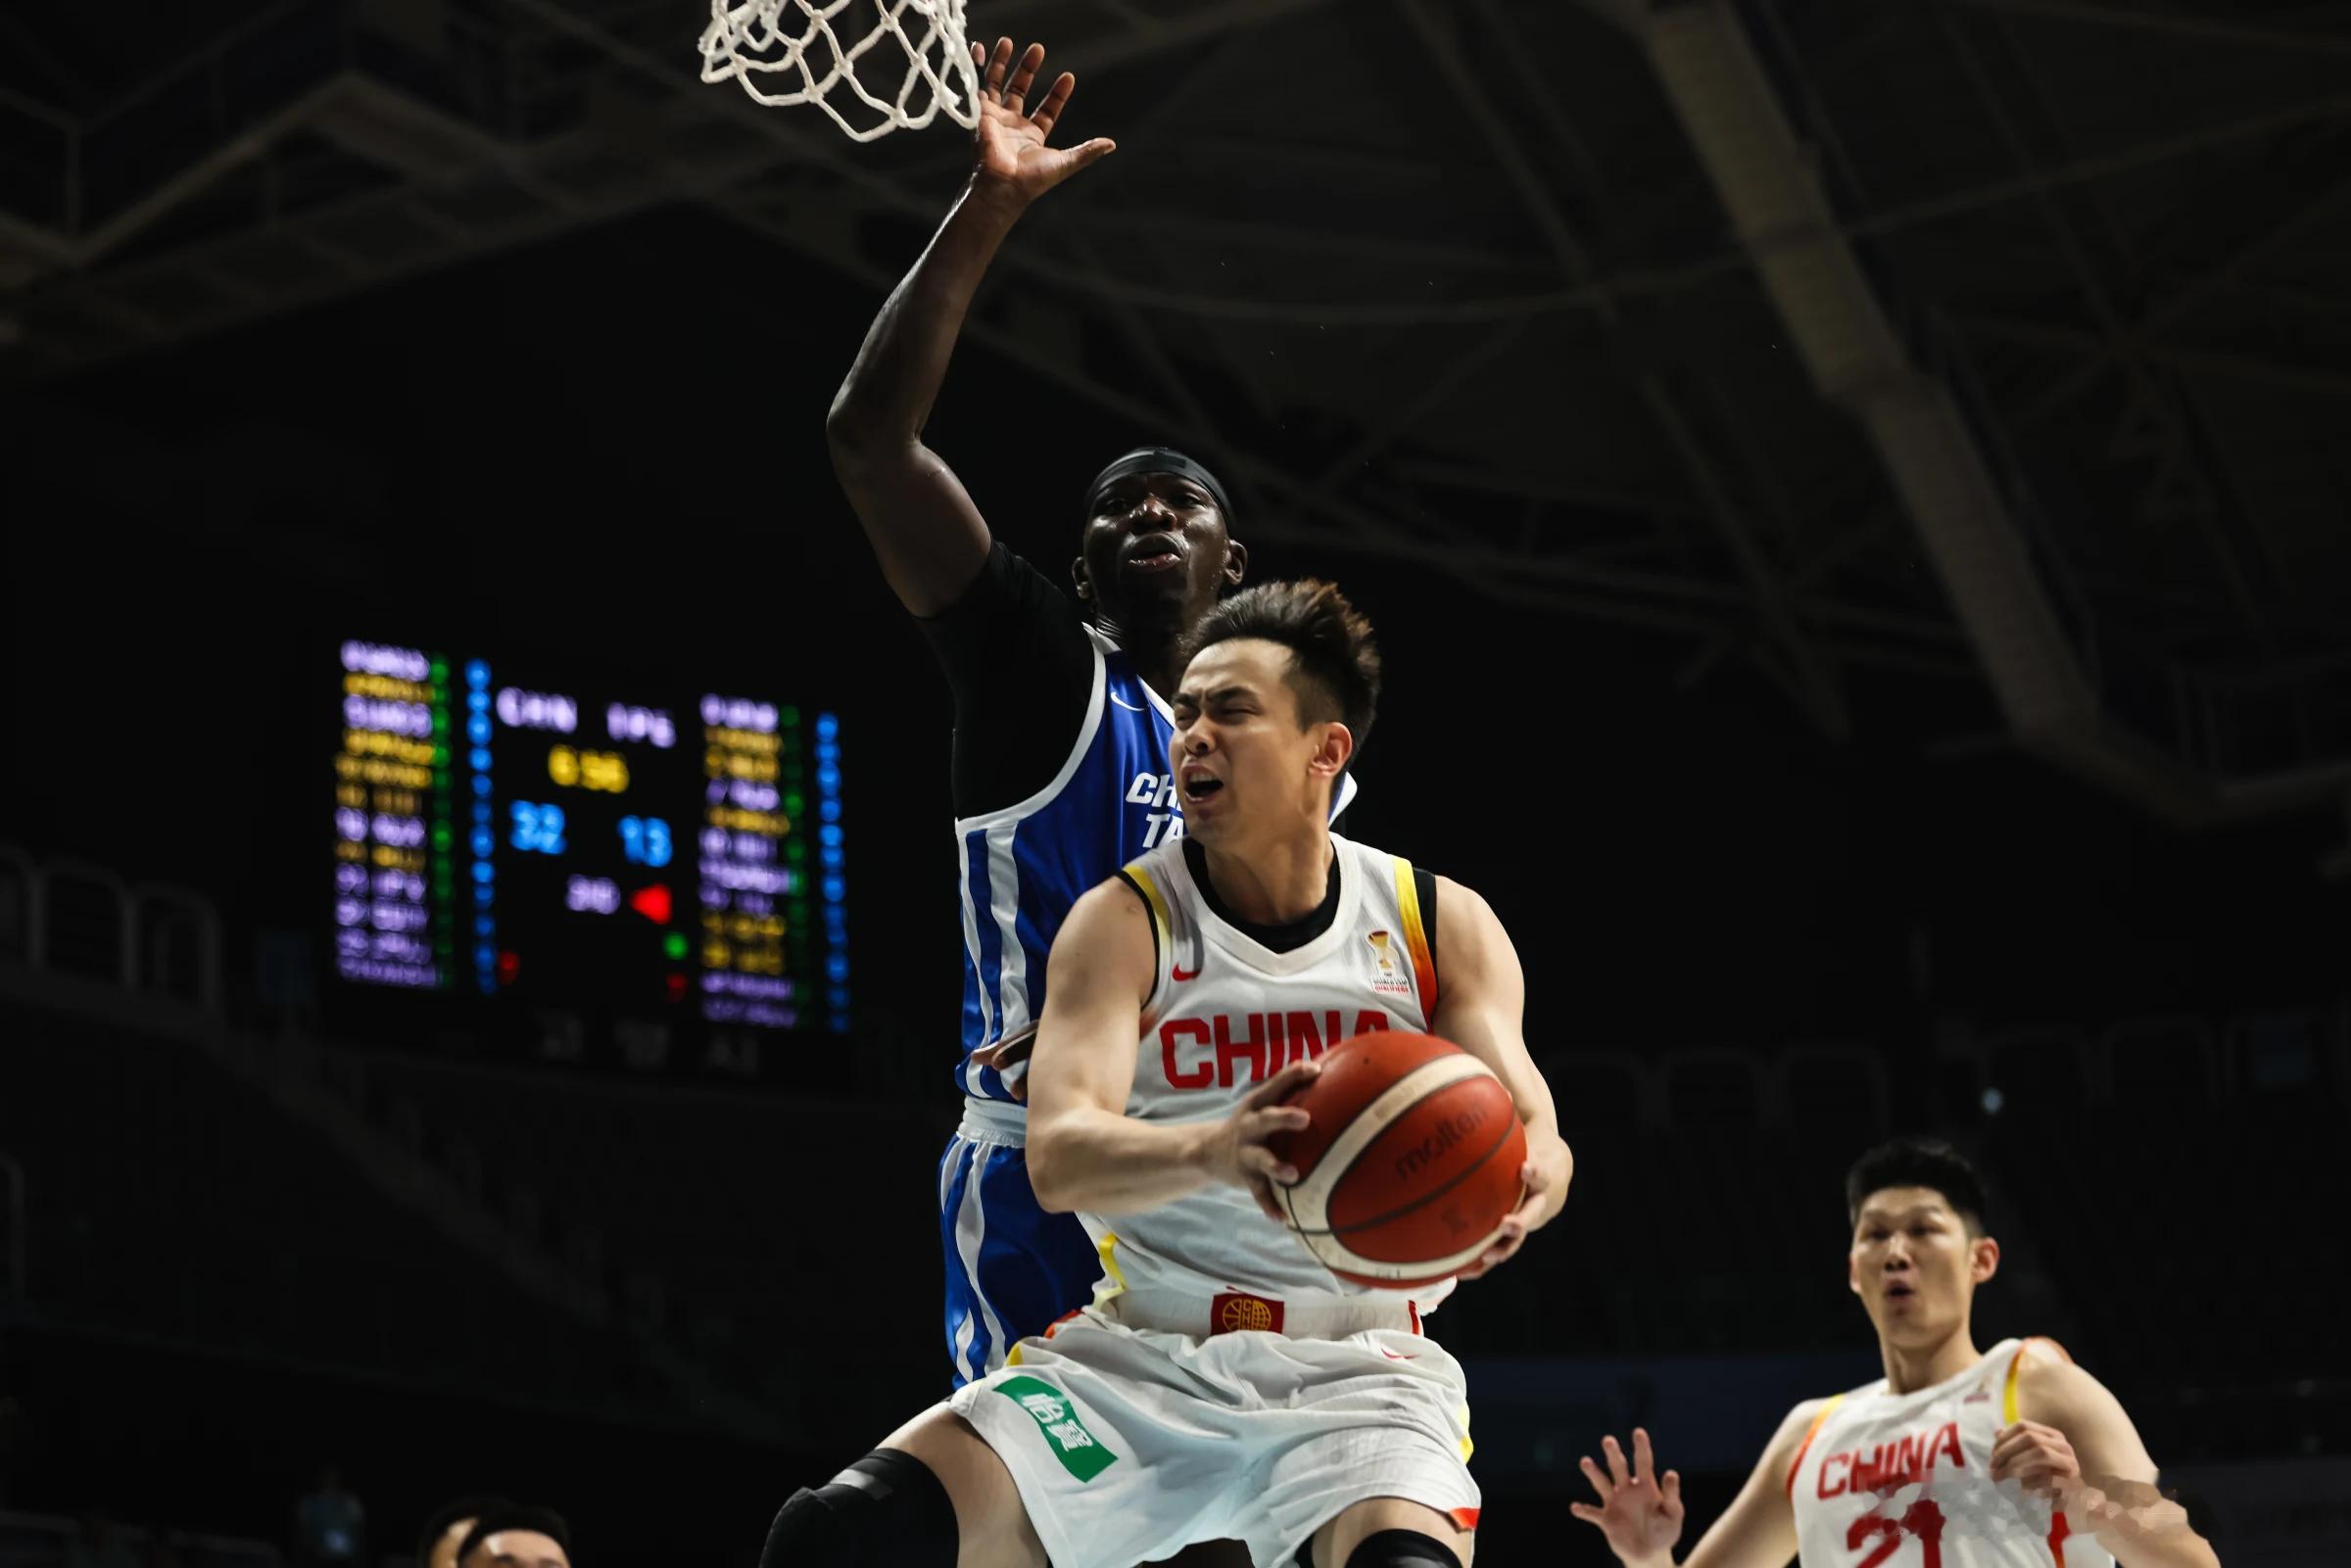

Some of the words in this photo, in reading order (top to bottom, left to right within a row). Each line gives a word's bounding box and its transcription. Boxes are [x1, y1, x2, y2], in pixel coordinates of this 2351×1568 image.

[1126, 772, 1183, 811] CH
[1395, 1103, 1490, 1183] molten
[1817, 1421, 1965, 1500] CHINA
